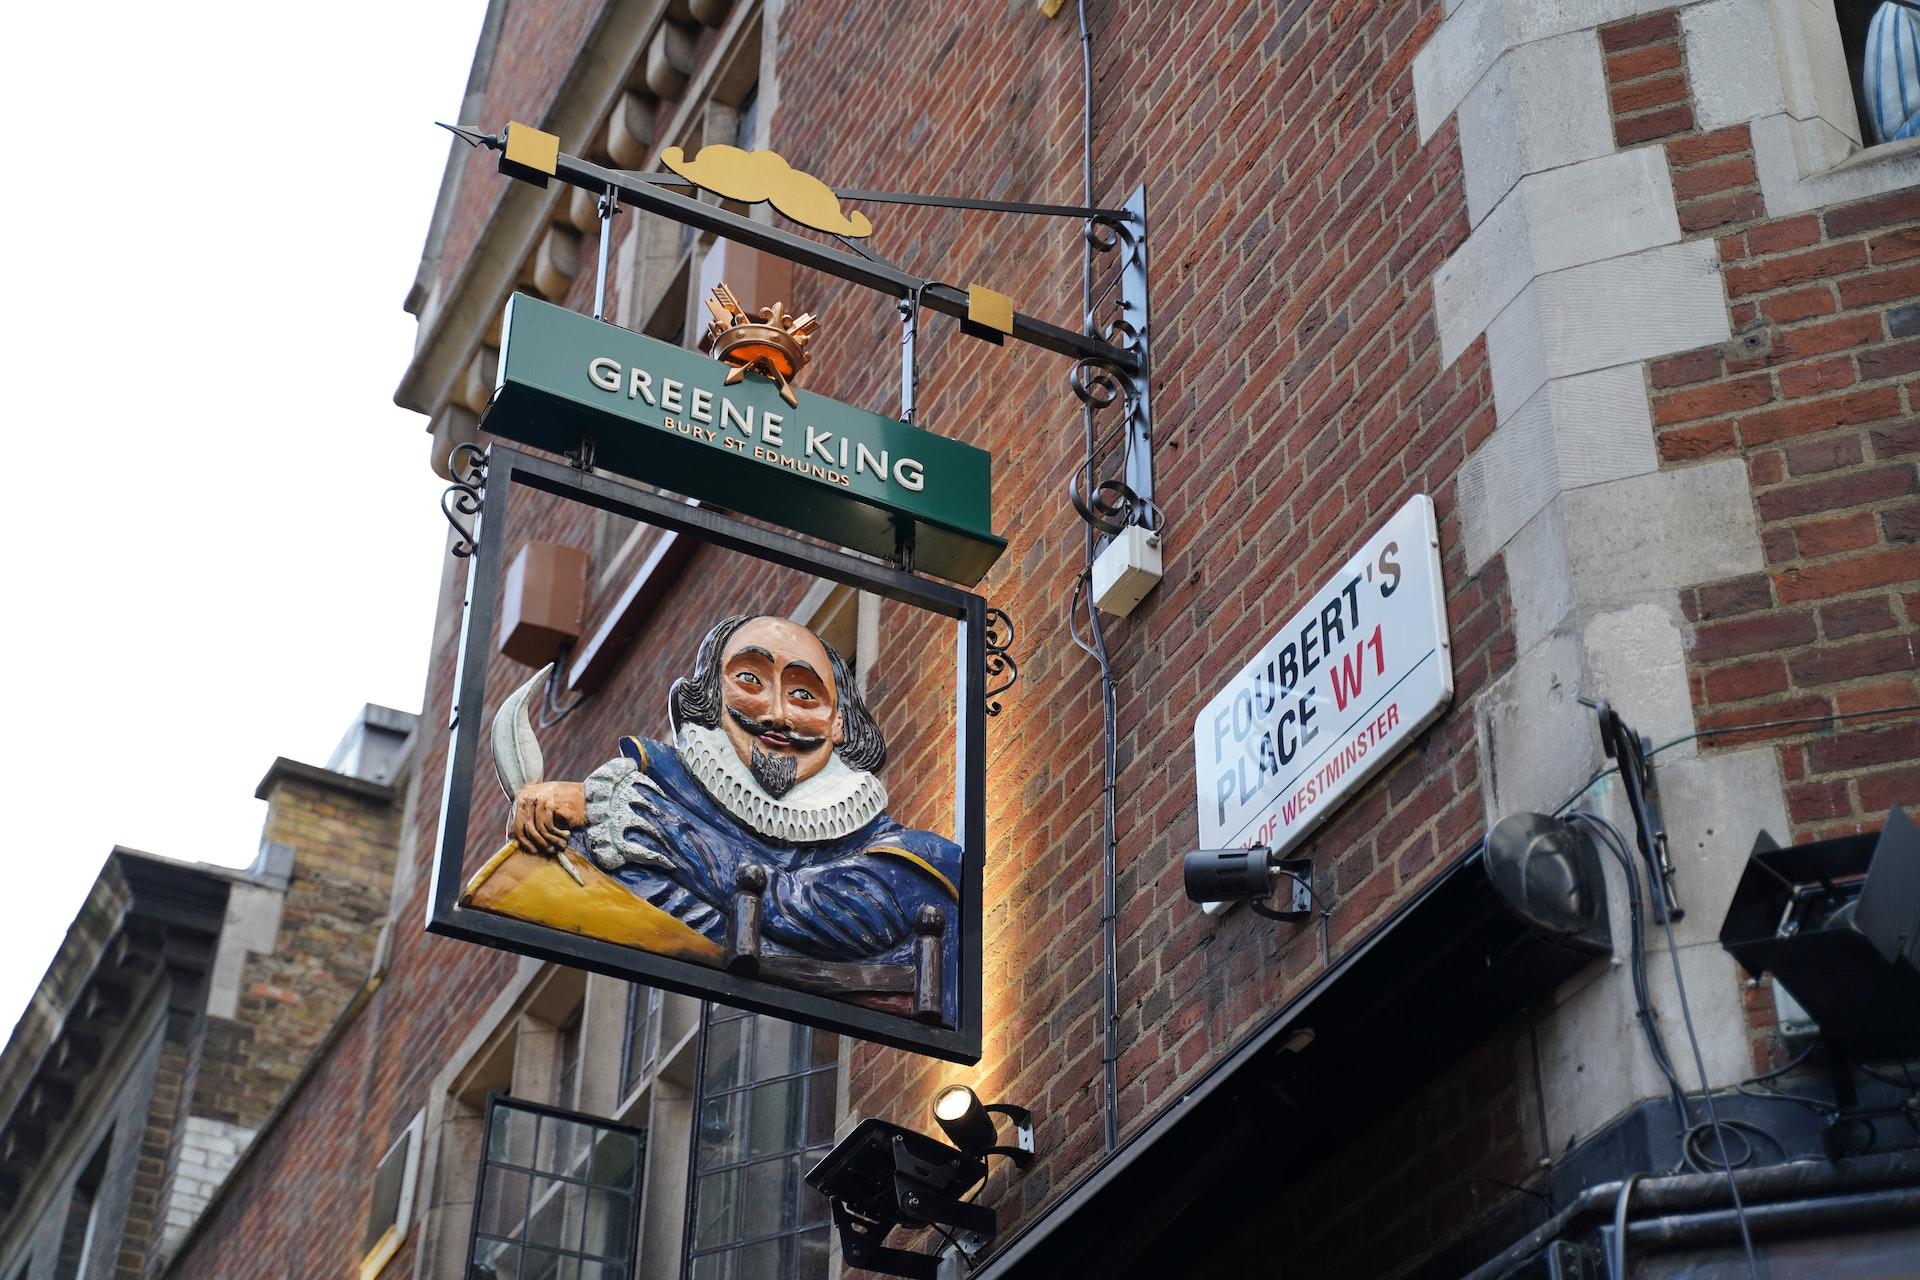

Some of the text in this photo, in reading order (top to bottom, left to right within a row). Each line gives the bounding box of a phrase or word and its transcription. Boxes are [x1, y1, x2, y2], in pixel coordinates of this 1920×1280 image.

[588, 357, 925, 492] GREENE KING
[663, 416, 851, 487] BURY ST EDMUNDS
[1213, 541, 1401, 765] FOUBERT'S
[1216, 623, 1386, 828] PLACE W1
[1258, 703, 1400, 848] OF WESTMINSTER
